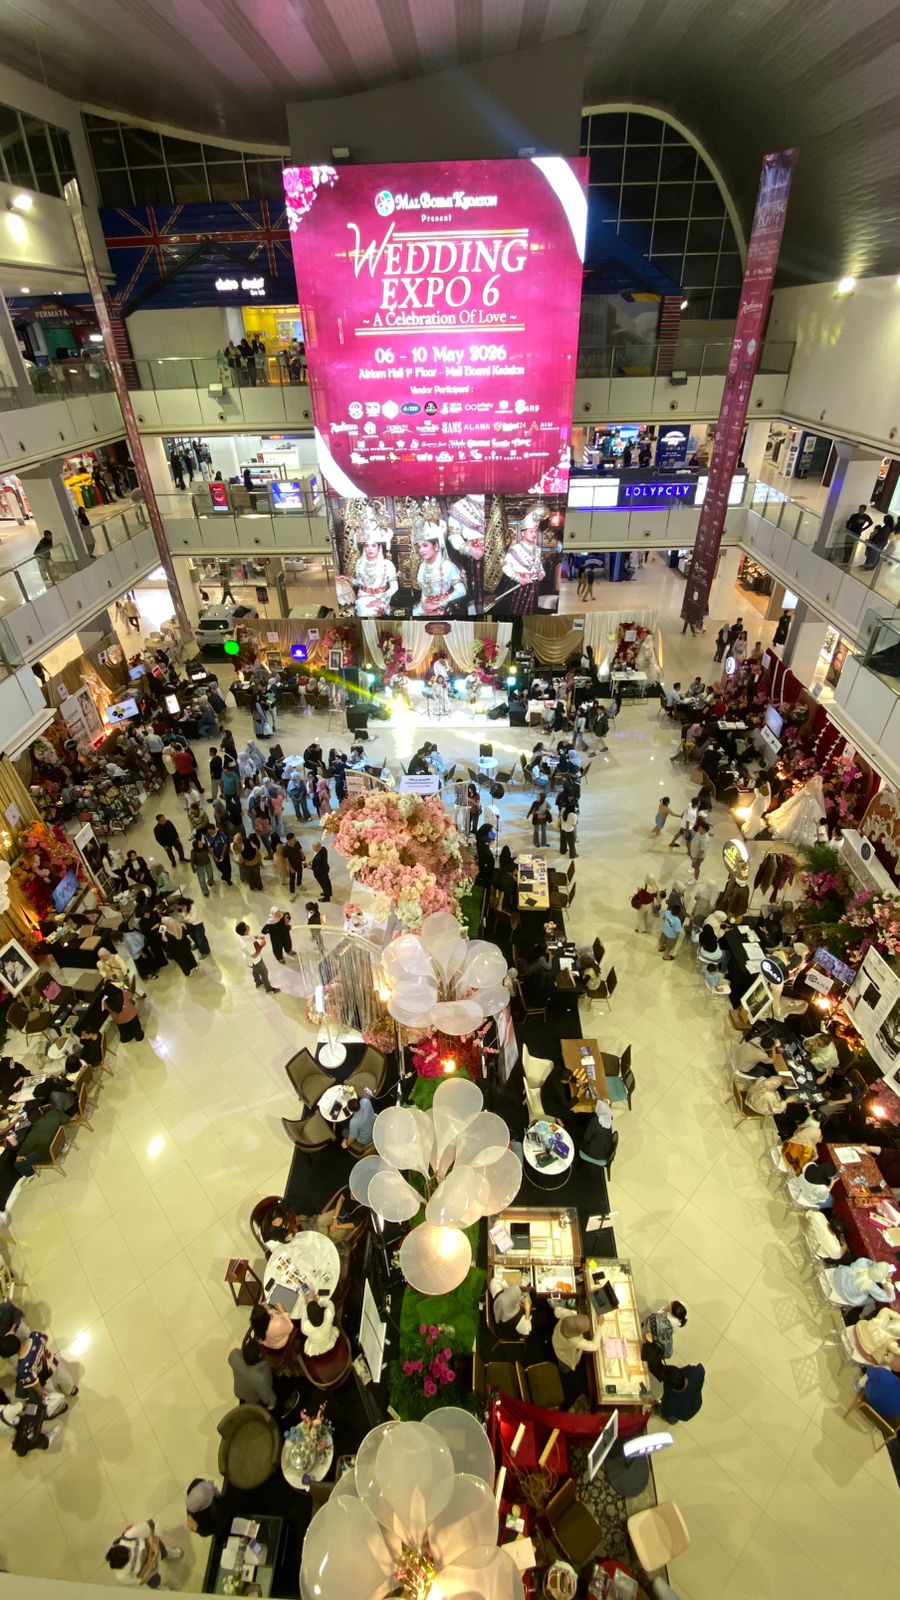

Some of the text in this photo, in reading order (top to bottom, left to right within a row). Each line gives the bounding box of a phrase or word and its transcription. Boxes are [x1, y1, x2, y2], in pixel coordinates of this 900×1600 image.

[421, 213, 452, 222] Present
[347, 222, 529, 279] WEDDING
[379, 274, 501, 310] EXPO 6
[35, 310, 69, 318] PERMATA
[372, 313, 384, 327] A
[386, 309, 456, 326] Celebration
[459, 310, 477, 324] Of
[478, 310, 507, 324] Love
[374, 347, 395, 364] 06
[411, 346, 428, 363] 10
[432, 345, 465, 366] May
[469, 344, 507, 362] 2026
[464, 423, 490, 431] ALANA
